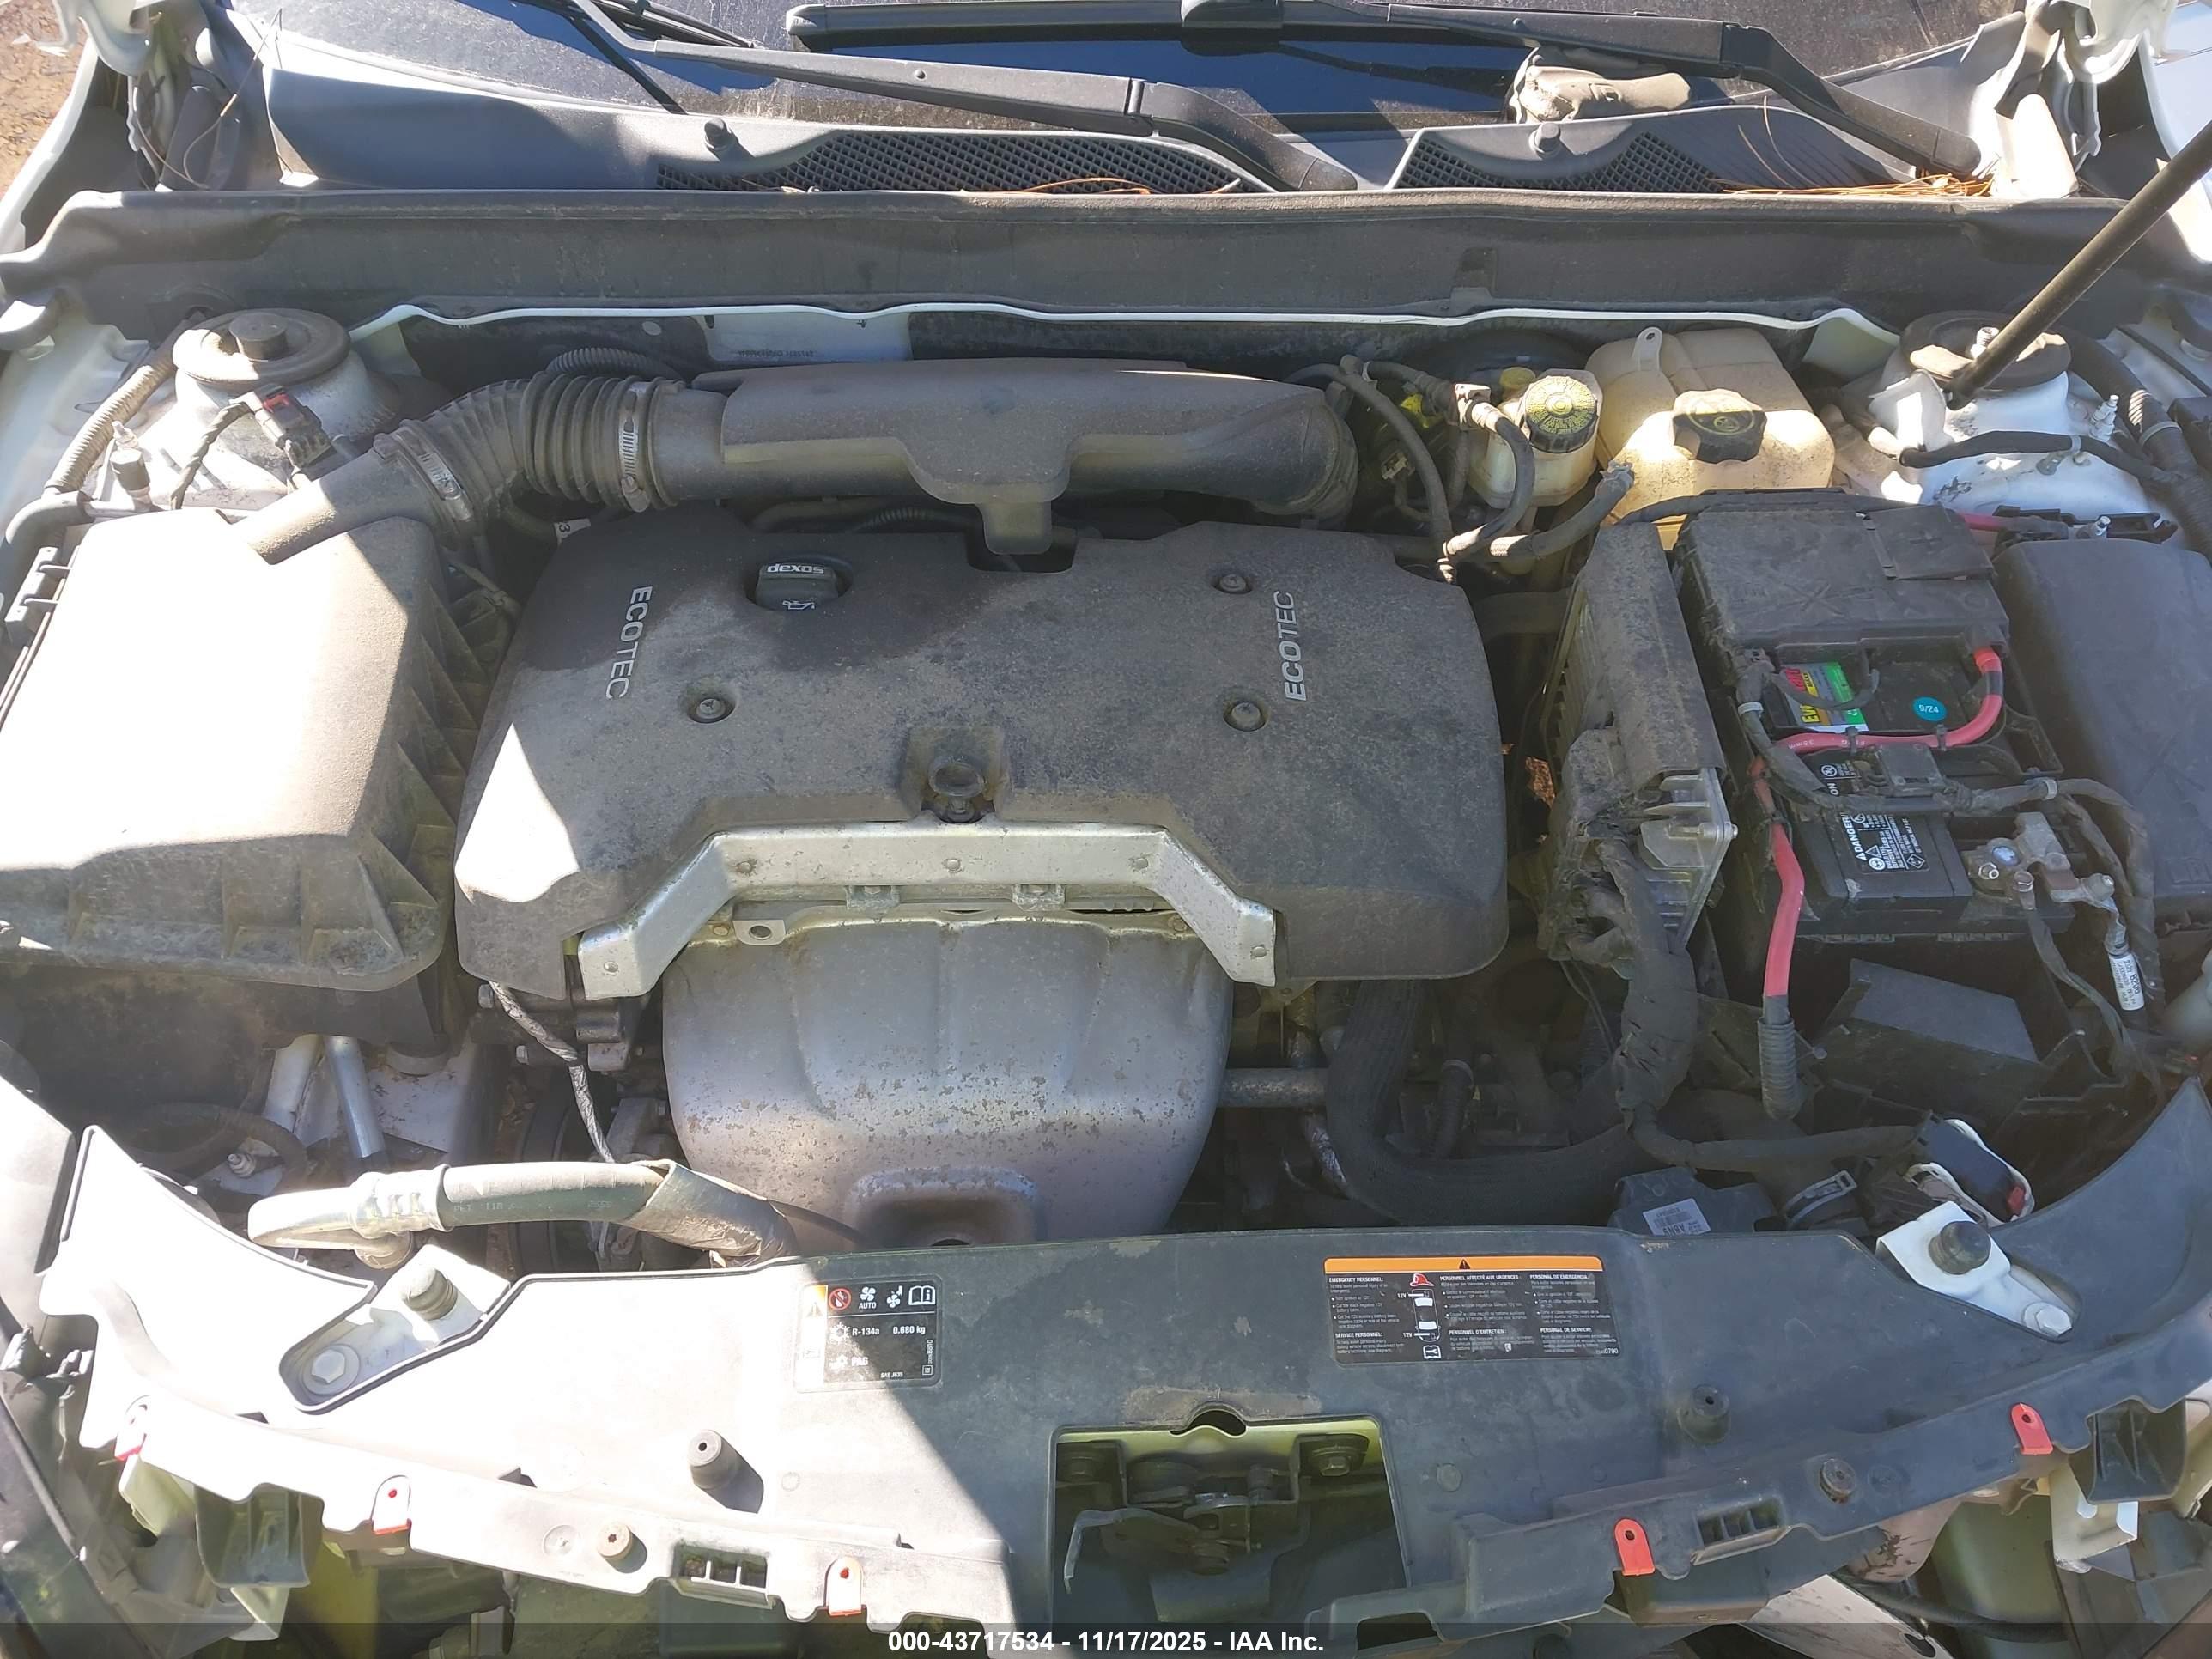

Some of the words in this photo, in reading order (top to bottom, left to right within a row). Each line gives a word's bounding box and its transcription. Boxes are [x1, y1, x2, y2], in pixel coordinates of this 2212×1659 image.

[767, 563, 825, 574] dexos
[605, 586, 653, 699] ECOTEC
[1273, 591, 1306, 701] ECOTEC
[852, 1328, 880, 1336] R-134a
[893, 1326, 915, 1334] 0.680
[916, 1326, 926, 1335] kg
